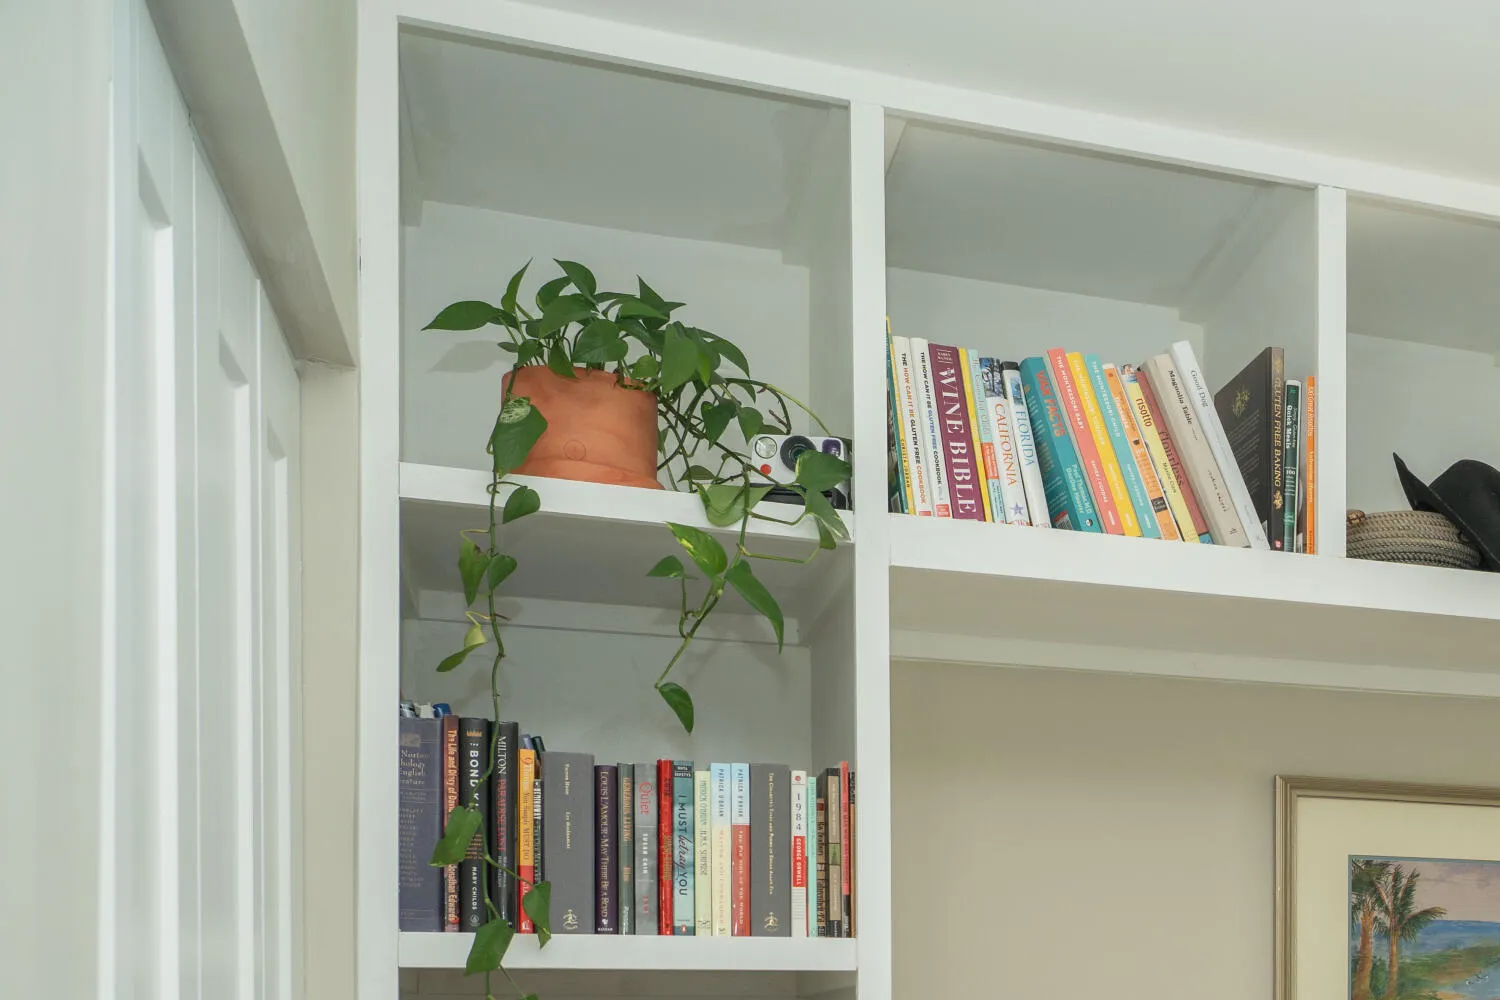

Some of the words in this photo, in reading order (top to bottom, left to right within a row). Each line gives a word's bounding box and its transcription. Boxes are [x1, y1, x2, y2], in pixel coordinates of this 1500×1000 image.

[1036, 370, 1051, 398] VAX
[1056, 356, 1064, 368] THE
[1061, 370, 1079, 412] MONTESSORI
[1074, 413, 1085, 430] BABY
[1091, 361, 1101, 374] THE
[1096, 375, 1114, 416] MONTESSORI
[1110, 418, 1121, 438] CHILD
[1168, 370, 1184, 404] Magnolia
[1181, 406, 1193, 425] Table
[1190, 370, 1203, 390] Good
[1197, 391, 1209, 408] Dog
[1274, 377, 1282, 418] GLUTEN
[909, 409, 915, 418] BE
[927, 401, 933, 409] BE
[939, 368, 965, 434] WINE
[1136, 398, 1153, 427] risotto
[910, 420, 918, 447] GLUTEN
[928, 410, 936, 434] GLUTEN
[1043, 399, 1067, 438] FACTS
[995, 404, 1017, 486] CALIFORNIA
[1015, 411, 1036, 467] FLORIDA
[933, 451, 943, 485] COOKBOOK
[1158, 431, 1185, 487] flourless
[916, 466, 926, 504] COOKBOOK
[949, 441, 977, 514] BIBLE
[448, 730, 457, 741] The
[448, 743, 457, 755] Life
[448, 756, 457, 768] and
[469, 750, 479, 788] BOND
[497, 736, 507, 775] MILTON
[447, 769, 457, 786] Diary
[448, 787, 457, 795] of
[600, 771, 608, 796] LOUIS
[497, 778, 507, 825] PARADISE
[638, 781, 653, 815] Quiet
[795, 793, 803, 831] 1984
[600, 797, 609, 834] L'AMOUR
[623, 816, 632, 842] LIVING
[678, 803, 688, 833] MUST
[497, 827, 506, 851] LOST
[601, 838, 609, 855] MAY
[673, 834, 694, 869] betray
[448, 864, 458, 893] Jonathan
[601, 881, 609, 890] BE
[678, 872, 688, 896] YOU
[448, 894, 457, 921] Edwards
